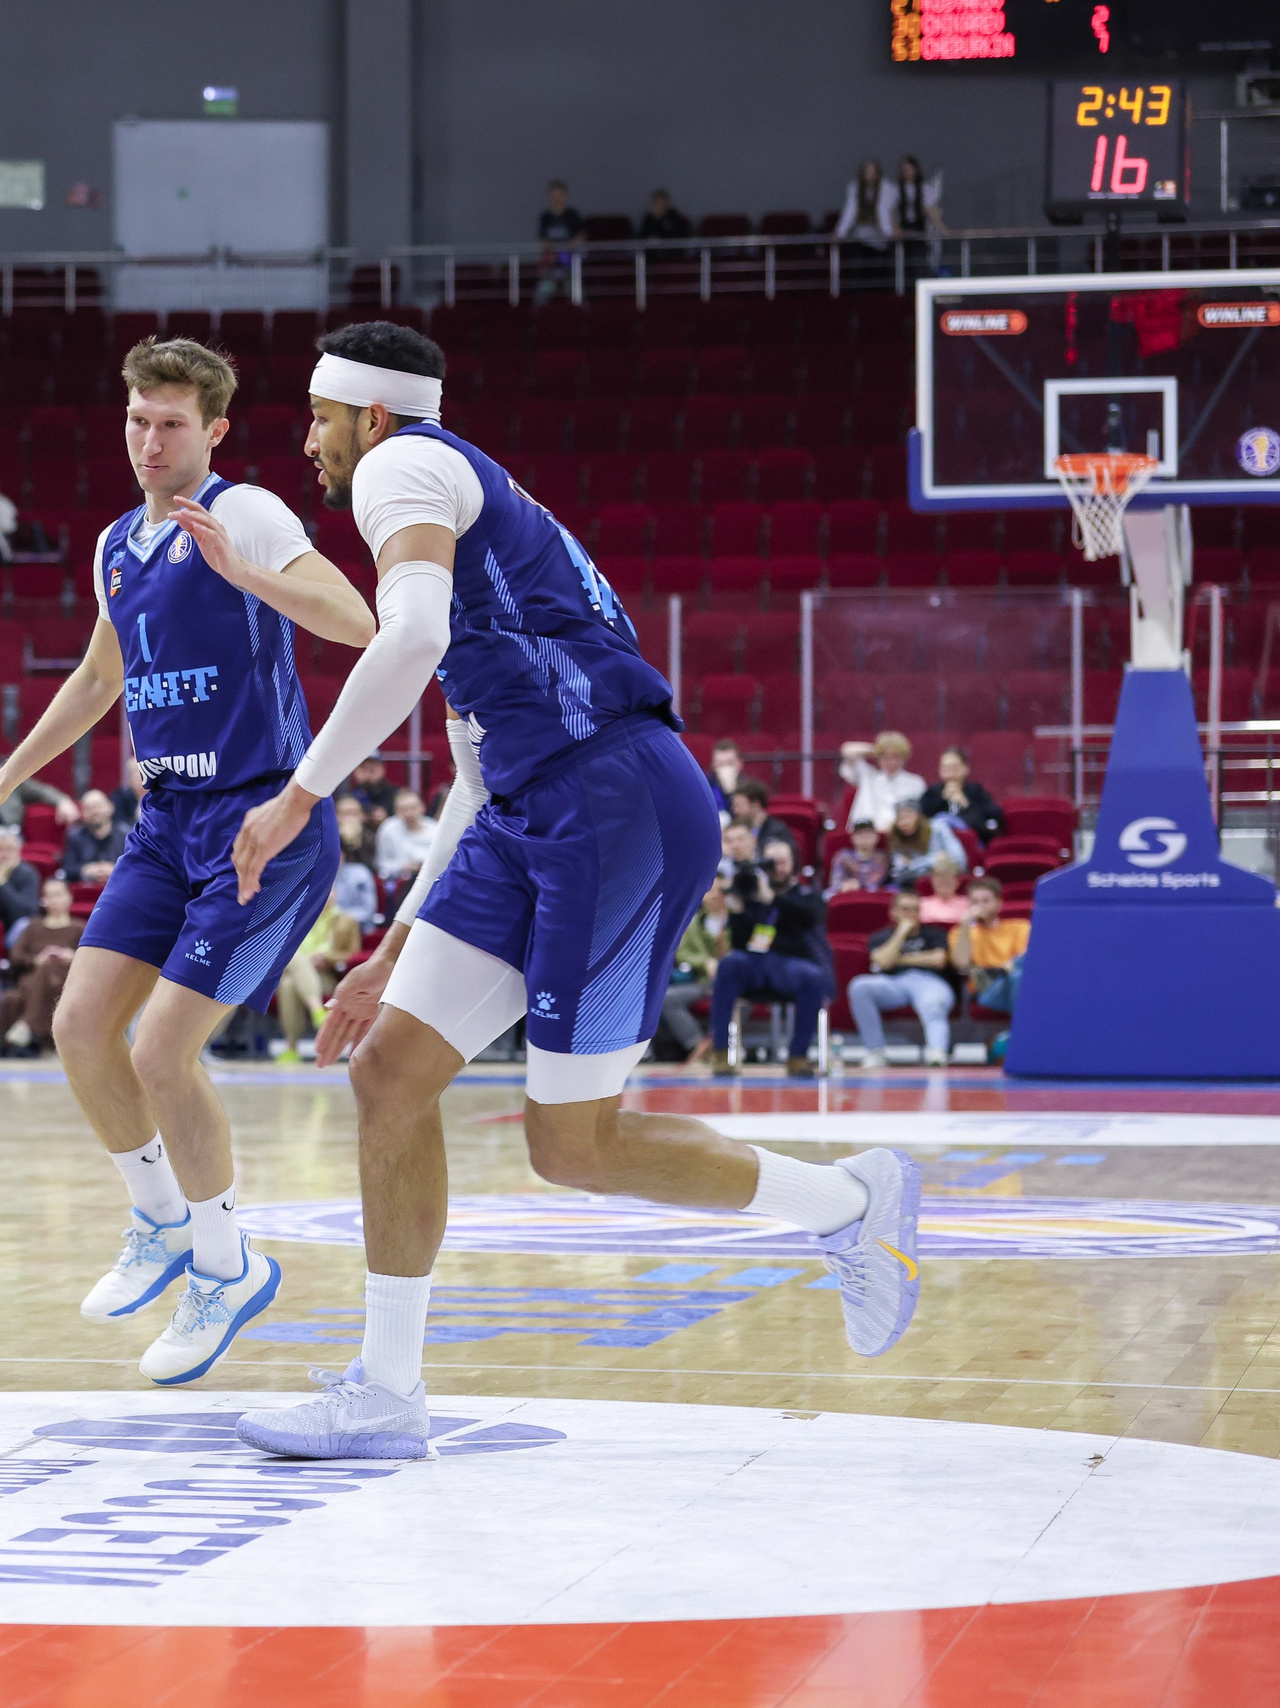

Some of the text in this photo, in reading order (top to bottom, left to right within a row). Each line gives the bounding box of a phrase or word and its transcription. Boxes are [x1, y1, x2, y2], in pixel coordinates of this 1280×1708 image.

[1076, 86, 1171, 126] 2:43
[1091, 135, 1148, 193] 16
[137, 613, 153, 663] 1
[125, 666, 218, 713] ENIT
[1161, 872, 1220, 889] Sports
[185, 952, 212, 967] KELME
[531, 1007, 561, 1019] KELME
